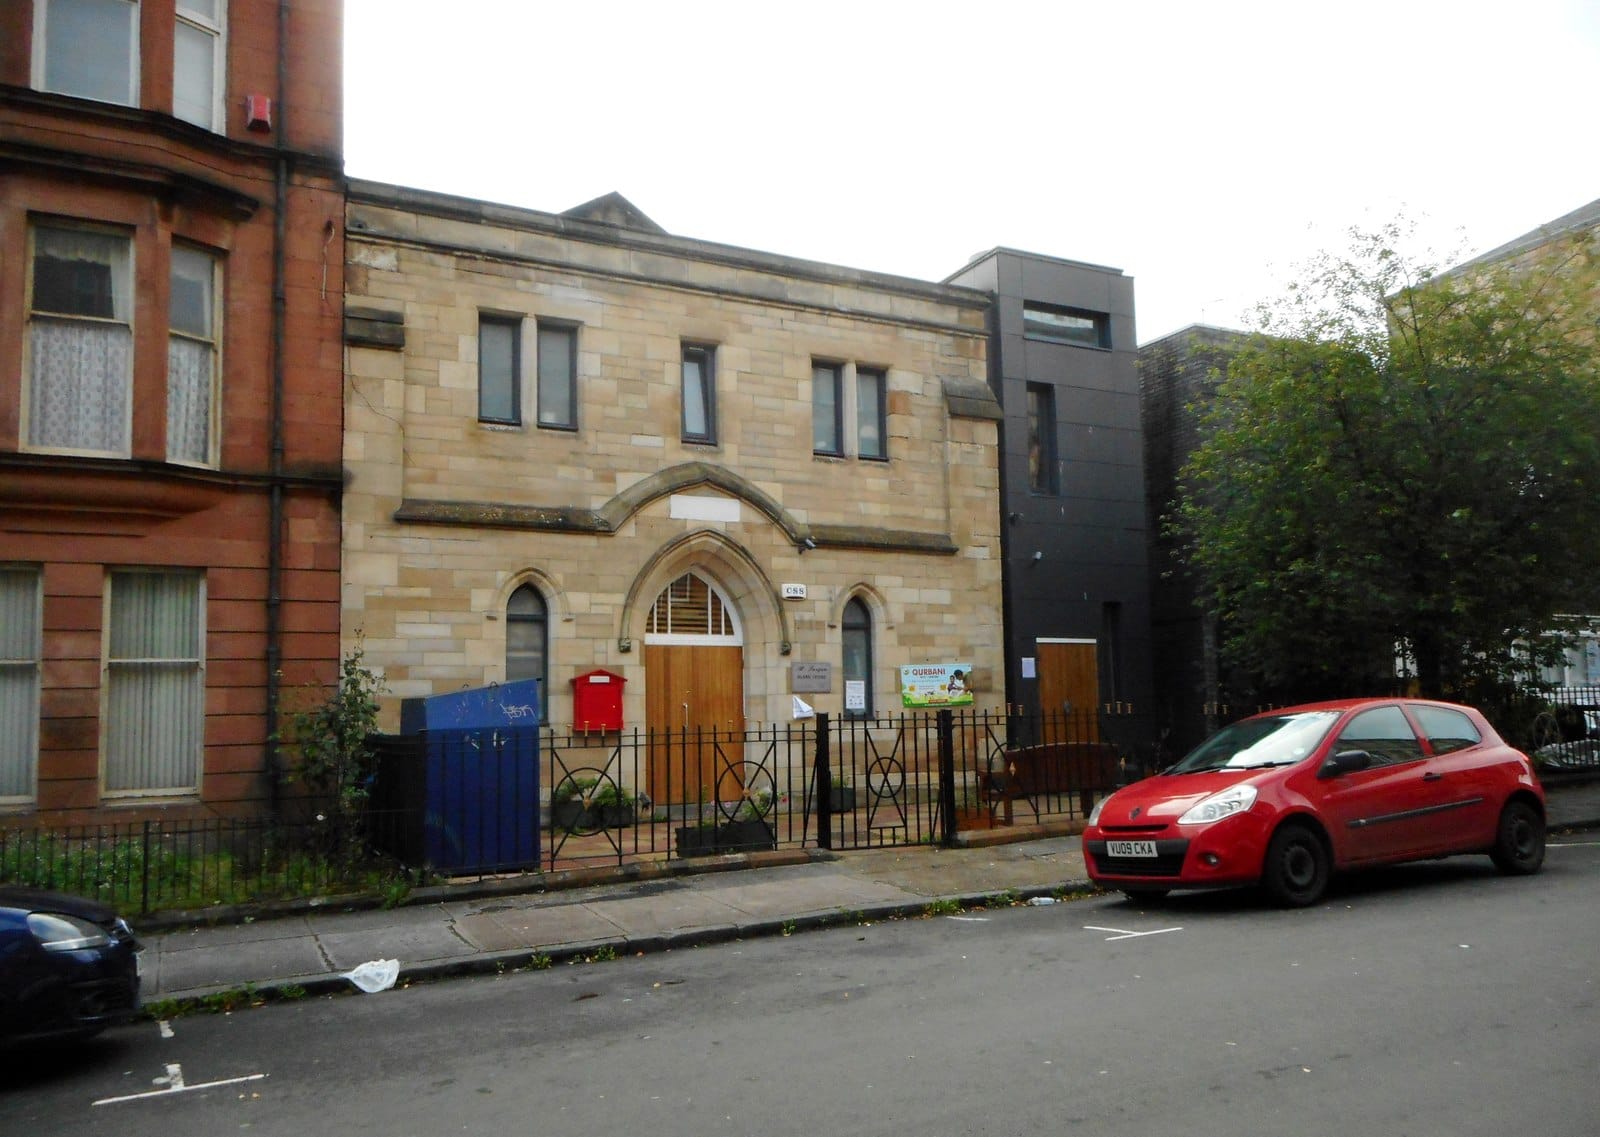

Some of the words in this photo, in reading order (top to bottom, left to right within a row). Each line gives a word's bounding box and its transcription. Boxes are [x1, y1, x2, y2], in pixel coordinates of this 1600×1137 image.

[911, 668, 946, 676] QURBANI
[1110, 842, 1133, 855] VU09
[1134, 842, 1153, 855] CKA
